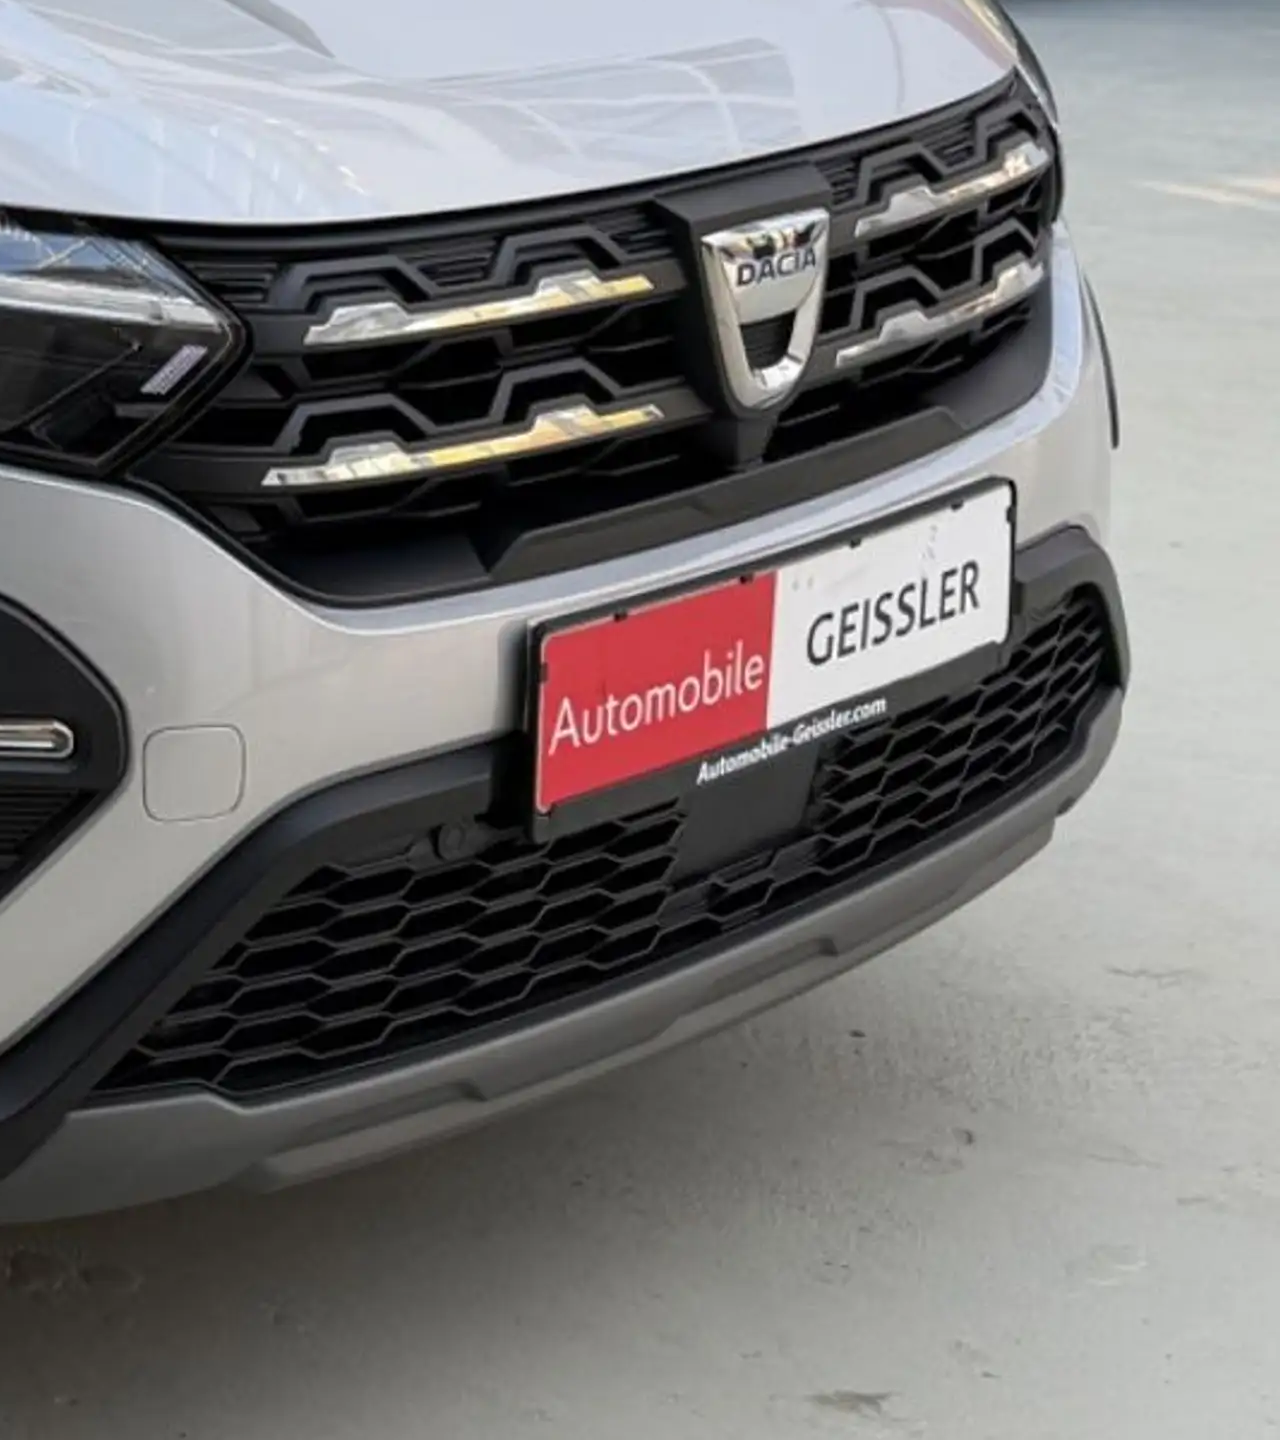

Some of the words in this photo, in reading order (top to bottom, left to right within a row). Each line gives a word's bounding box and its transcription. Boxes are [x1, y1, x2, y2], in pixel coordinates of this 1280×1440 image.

[736, 247, 817, 287] DACIA
[806, 559, 981, 666] GEISSLER
[547, 638, 765, 756] Automobile
[696, 697, 888, 786] Automobile-Geissler.com
